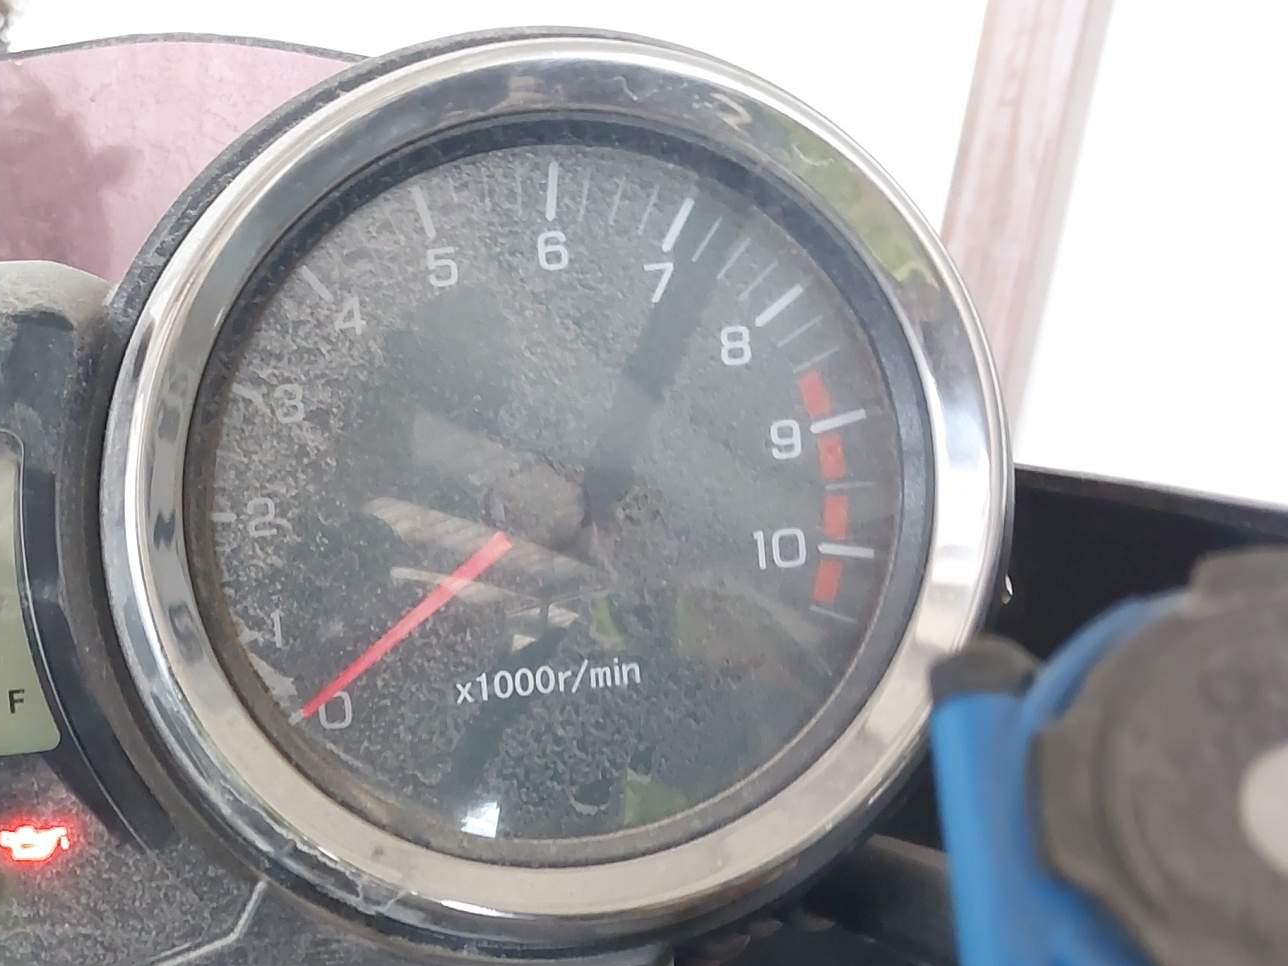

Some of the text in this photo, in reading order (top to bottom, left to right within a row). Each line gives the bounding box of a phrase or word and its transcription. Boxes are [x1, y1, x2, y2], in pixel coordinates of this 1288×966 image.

[427, 247, 460, 288] 5
[537, 230, 569, 271] 6
[643, 262, 675, 304] 7
[335, 297, 367, 335] 4
[720, 325, 752, 366] 8
[770, 419, 802, 460] 9
[247, 497, 278, 537] 2
[753, 527, 807, 570] 10
[269, 610, 284, 649] 1
[7, 688, 26, 714] F
[455, 657, 642, 705] x1000r/min
[318, 691, 353, 730] 0
